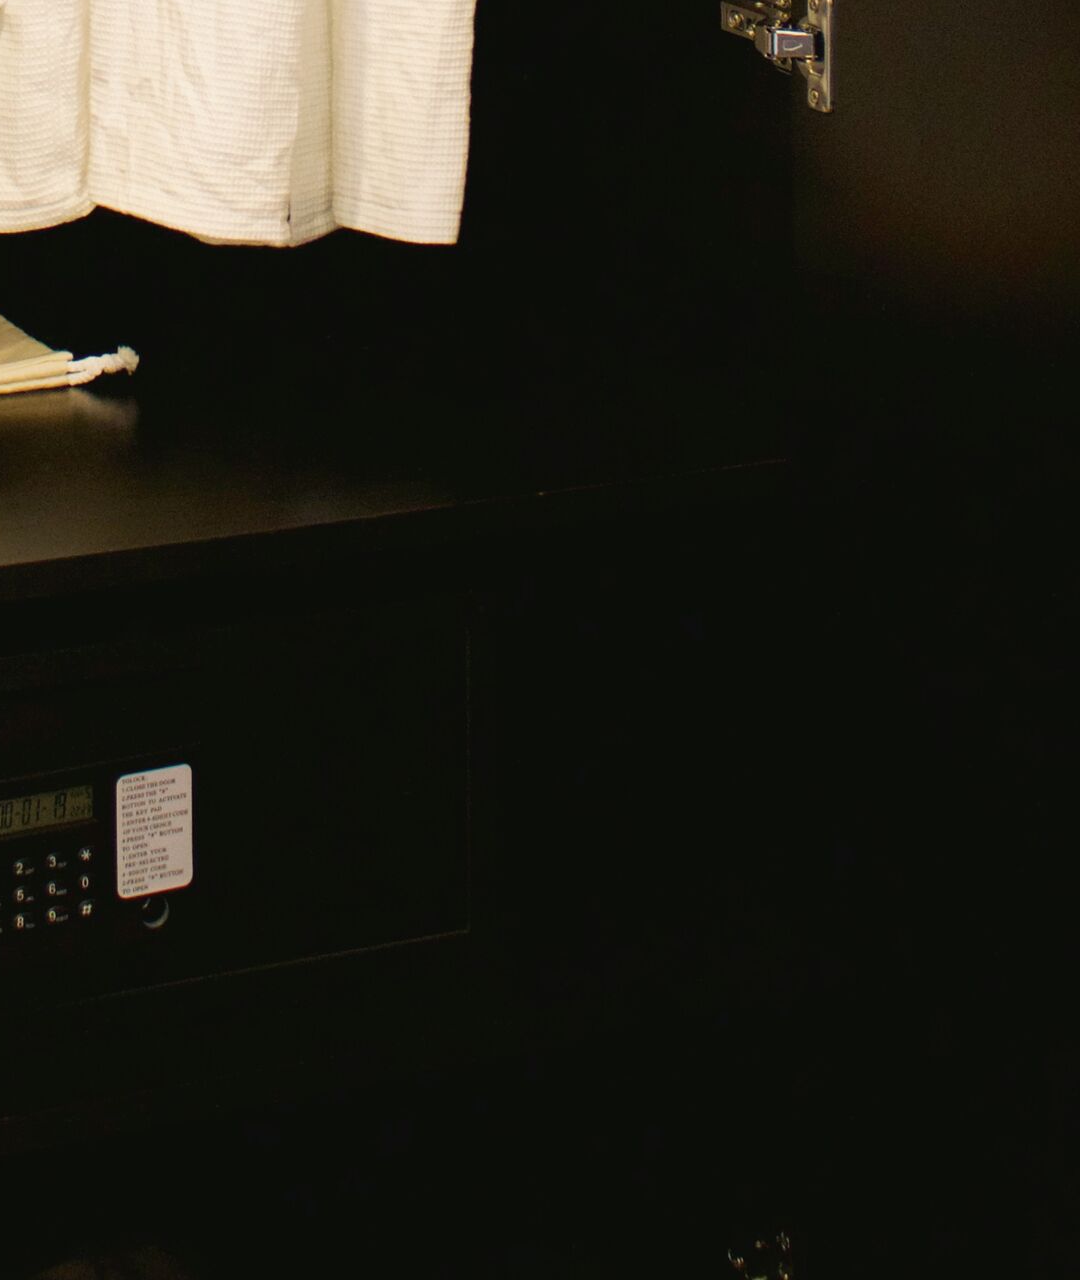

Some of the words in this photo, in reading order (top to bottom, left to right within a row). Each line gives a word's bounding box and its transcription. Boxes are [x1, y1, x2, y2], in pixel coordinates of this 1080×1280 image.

[16, 862, 24, 874] 2
[49, 855, 57, 868] 3
[16, 889, 24, 901] 5
[48, 883, 56, 895] 6
[81, 876, 89, 888] 0
[16, 916, 24, 928] 8
[48, 910, 56, 922] 9
